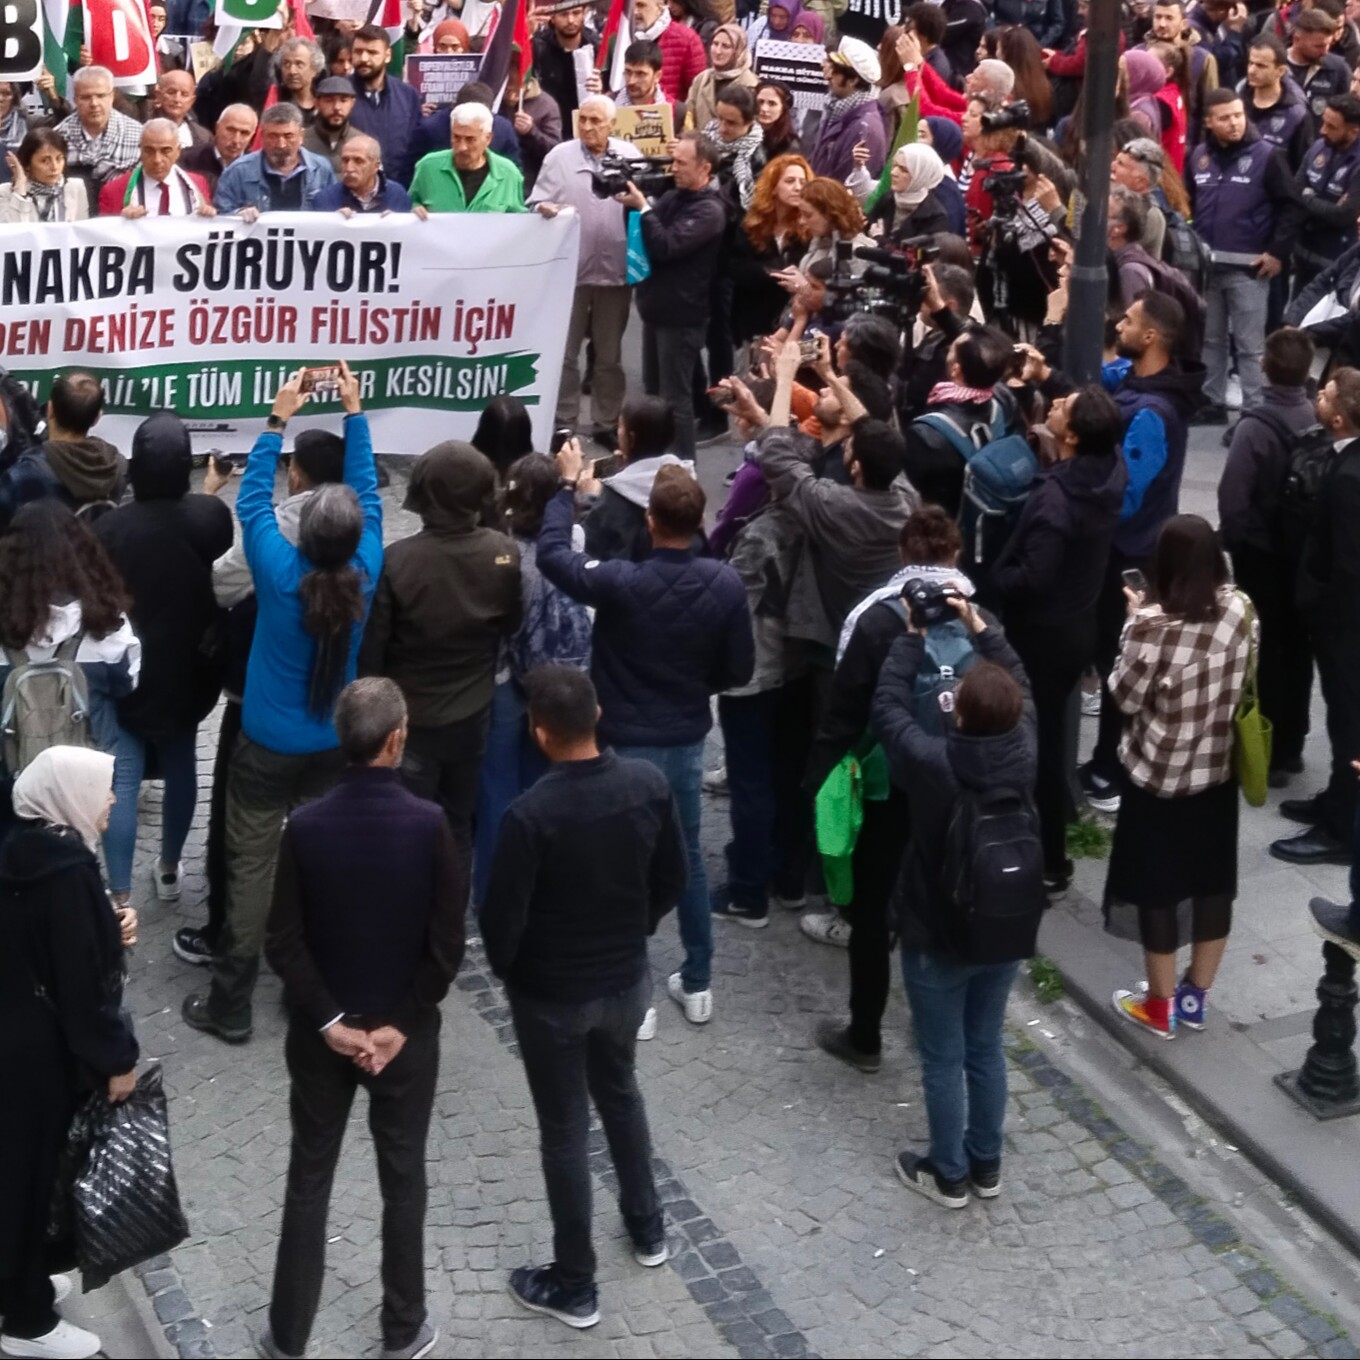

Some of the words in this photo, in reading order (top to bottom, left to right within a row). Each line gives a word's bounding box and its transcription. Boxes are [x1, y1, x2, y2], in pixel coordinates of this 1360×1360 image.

[1, 243, 155, 306] NAKBA
[171, 227, 403, 296] SÜRÜYOR!
[63, 302, 174, 356] DENİZE
[188, 296, 297, 347] ÖZGÜR
[310, 300, 442, 346] FİLİSTİN
[453, 297, 516, 356] İÇİN
[187, 364, 242, 409] TÜM
[384, 359, 509, 400] KESİLSİN!
